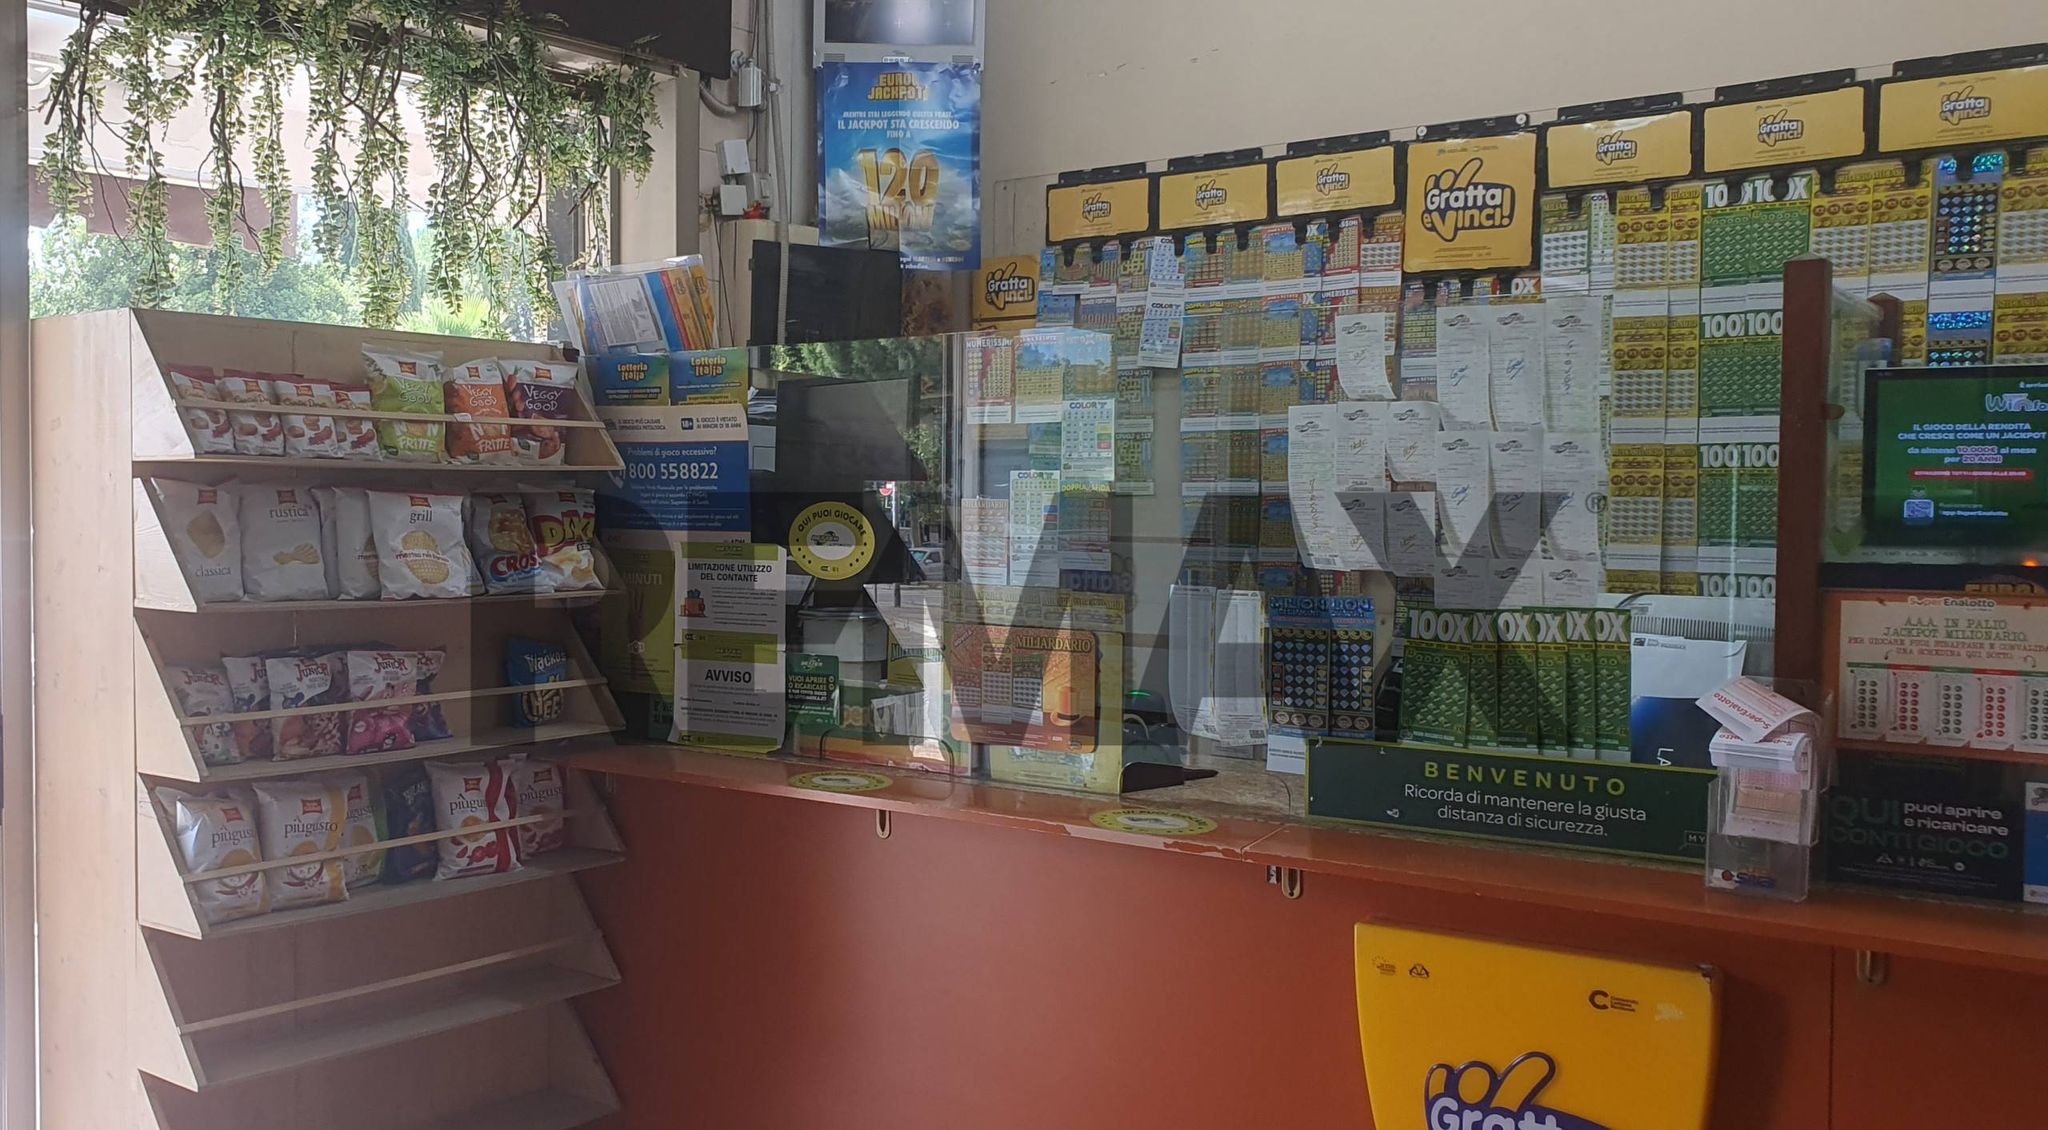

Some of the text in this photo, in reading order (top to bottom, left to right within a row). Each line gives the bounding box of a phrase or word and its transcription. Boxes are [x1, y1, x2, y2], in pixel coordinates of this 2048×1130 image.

[879, 73, 918, 86] EURO
[1942, 98, 1985, 112] Gratta
[838, 120, 960, 130] IL JACKPOT STA CRESCENDO
[1759, 120, 1798, 133] Gratta
[887, 131, 904, 139] FINO
[1598, 141, 1632, 152] Gratta
[858, 147, 940, 201] 120
[1317, 173, 1345, 184] Gratta
[1195, 189, 1224, 200] Gratta
[1426, 185, 1503, 210] Gratta
[987, 277, 1028, 292] Gratta
[617, 362, 648, 373] Lotteria
[689, 356, 727, 367] Lotteria
[1069, 402, 1098, 410] COLOR
[1922, 423, 1954, 431] GIOCO
[1955, 423, 1987, 431] DELLA
[1988, 423, 2031, 431] RENDITA
[1897, 432, 1917, 440] CHE
[1918, 432, 1955, 440] CRESCE
[1956, 432, 1984, 440] COME
[2001, 431, 2047, 440] JACKPOT
[627, 446, 654, 457] Problemi
[660, 448, 681, 459] gioco
[681, 446, 717, 457] eccessivo?
[1962, 455, 1975, 463] 20
[629, 462, 718, 480] 800 558822
[269, 504, 310, 519] rustica
[409, 510, 433, 525] grill
[797, 509, 867, 537] QUI PUOI GIOCARE
[491, 554, 540, 576] CROS
[687, 562, 773, 574] LIMITAZIONE UTILIZZO
[700, 573, 759, 583] DEL CONTANTE
[1410, 611, 1470, 643] 100X
[1944, 618, 1959, 628] IN
[1966, 619, 2008, 630] PALIO
[1883, 627, 1940, 640] JACKPOT
[1014, 634, 1093, 653] MILIARDARIO
[705, 668, 752, 684] AVVISO
[788, 675, 827, 684] VUOI APRIRE
[794, 683, 827, 691] RICARICARE
[1713, 692, 1772, 731] SuperEnalotto
[1424, 761, 1626, 796] BENVENUTO
[1404, 783, 1647, 822] Ricorda di mantenere la giusta
[1903, 801, 1943, 816] puoi
[1945, 805, 2002, 821] aprire
[1437, 804, 1608, 838] distanza di sicurezza.
[1903, 817, 2009, 837] e ricaricare
[1829, 826, 2010, 859] CONTI GIOCO
